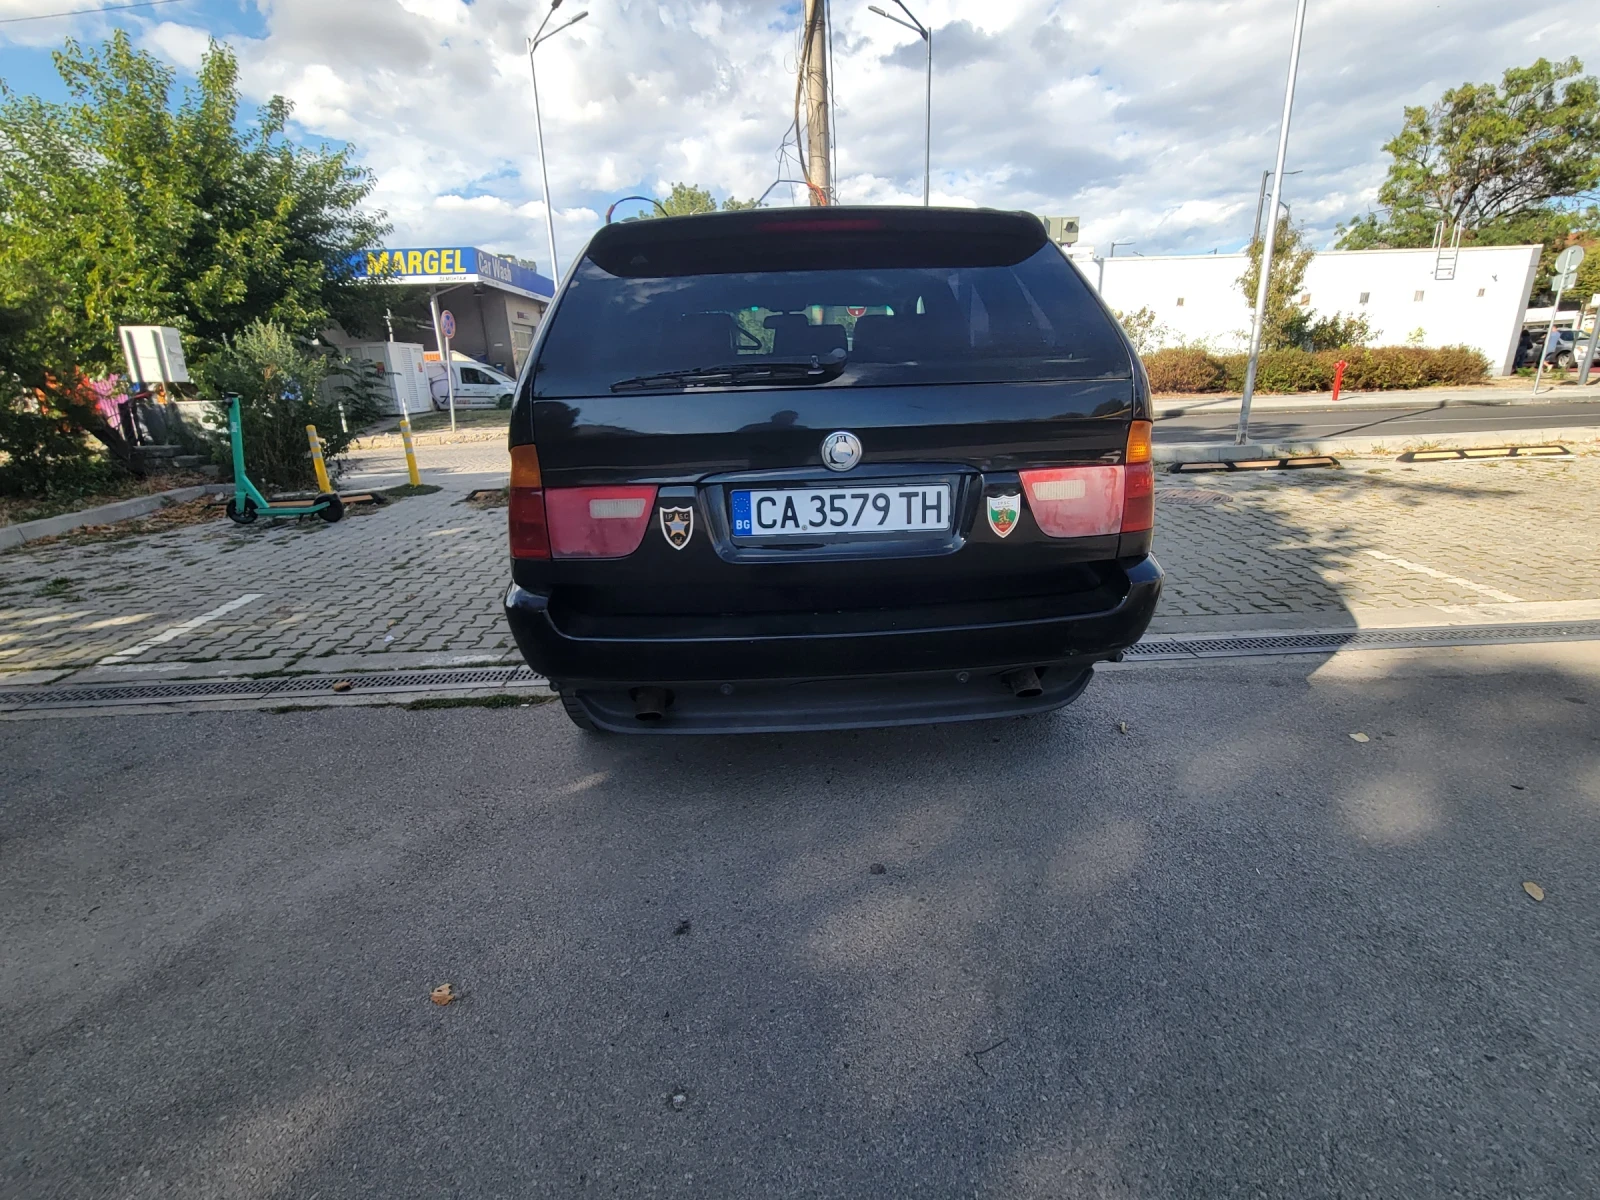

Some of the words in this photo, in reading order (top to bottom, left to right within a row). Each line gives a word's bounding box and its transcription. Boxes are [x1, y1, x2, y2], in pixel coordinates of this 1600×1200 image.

[367, 250, 466, 275] MARGEL
[478, 252, 492, 276] Car
[492, 257, 512, 282] Wash
[756, 496, 800, 529] CA
[808, 492, 891, 527] 3579
[899, 490, 942, 524] TH
[735, 519, 751, 530] BG
